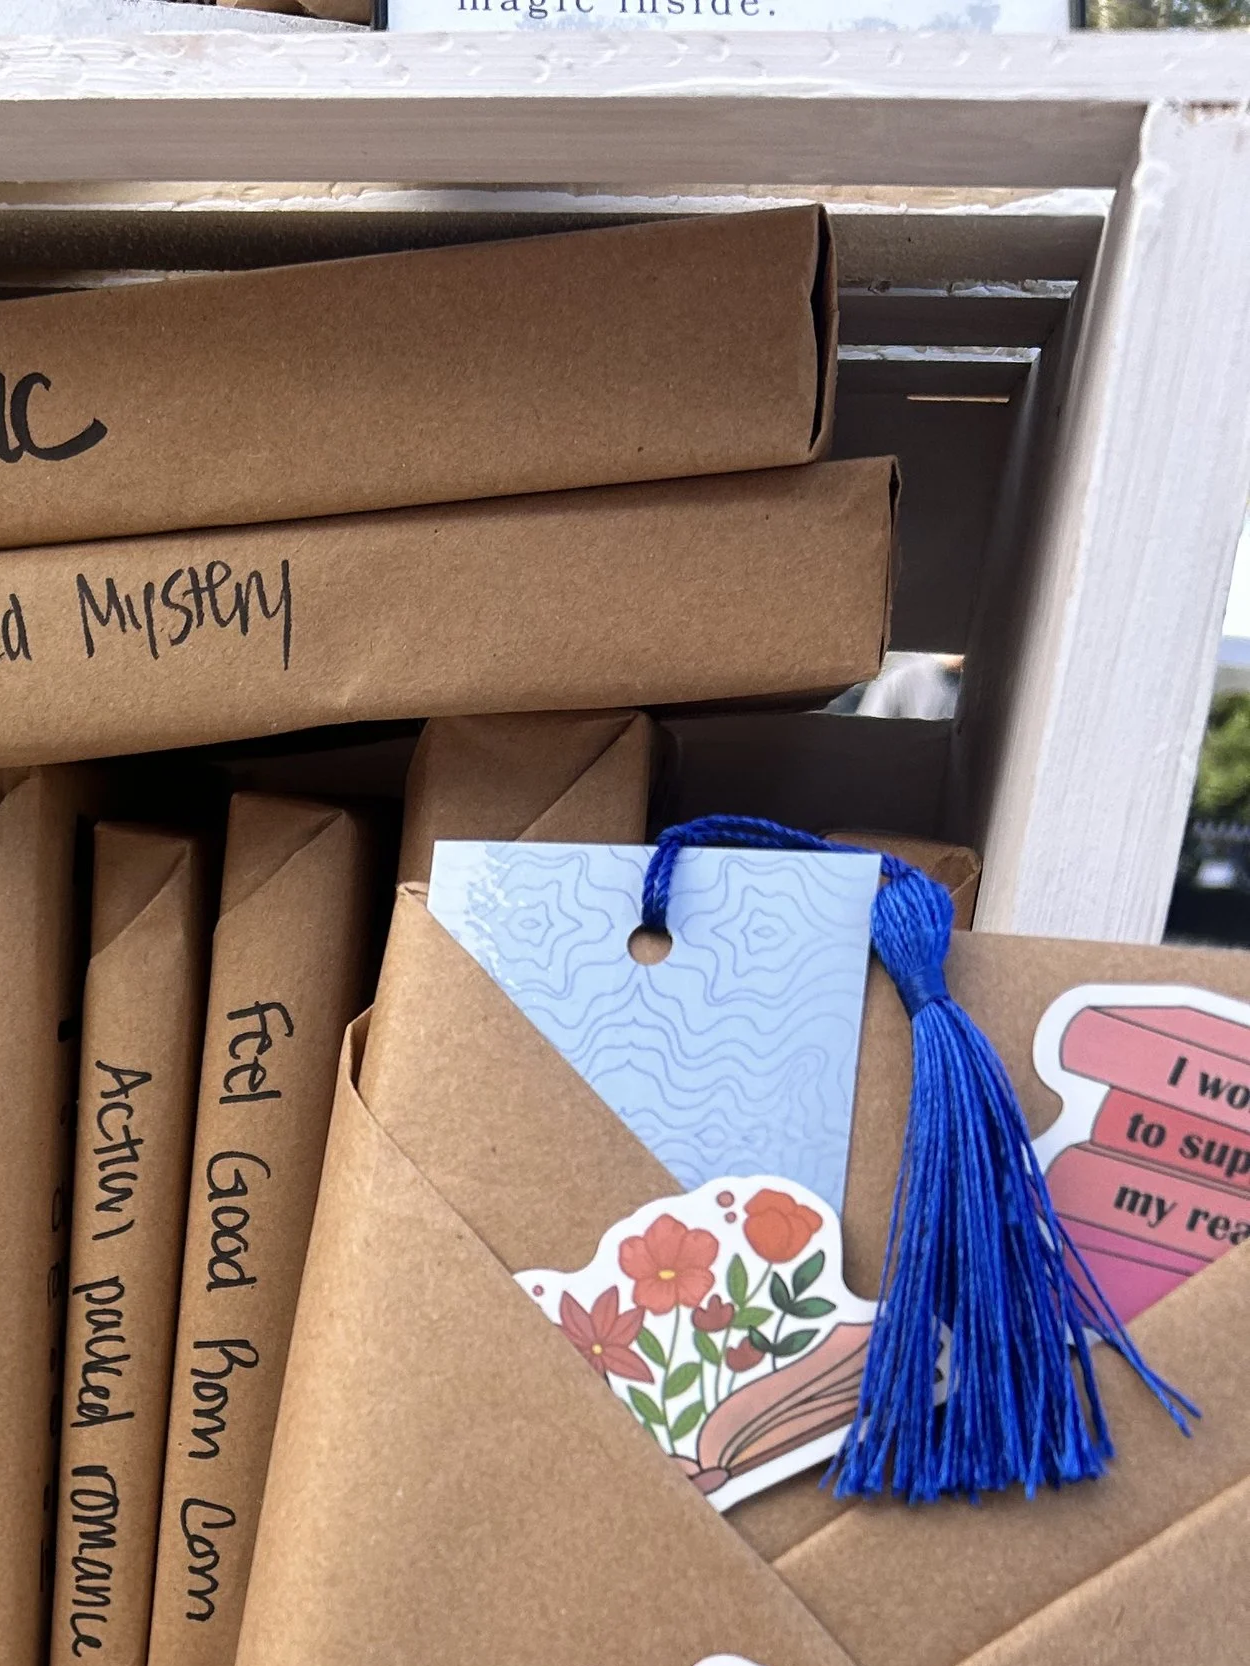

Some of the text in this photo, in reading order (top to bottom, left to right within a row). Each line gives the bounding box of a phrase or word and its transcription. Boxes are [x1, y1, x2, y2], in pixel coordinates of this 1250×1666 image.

[76, 559, 291, 672] Mystery
[1167, 1056, 1188, 1087] I
[1126, 1112, 1166, 1149] to
[1113, 1184, 1177, 1228] my
[71, 1275, 135, 1428] packed
[180, 1001, 295, 1622] Feel Good Rom Com
[70, 1465, 120, 1657] romance
